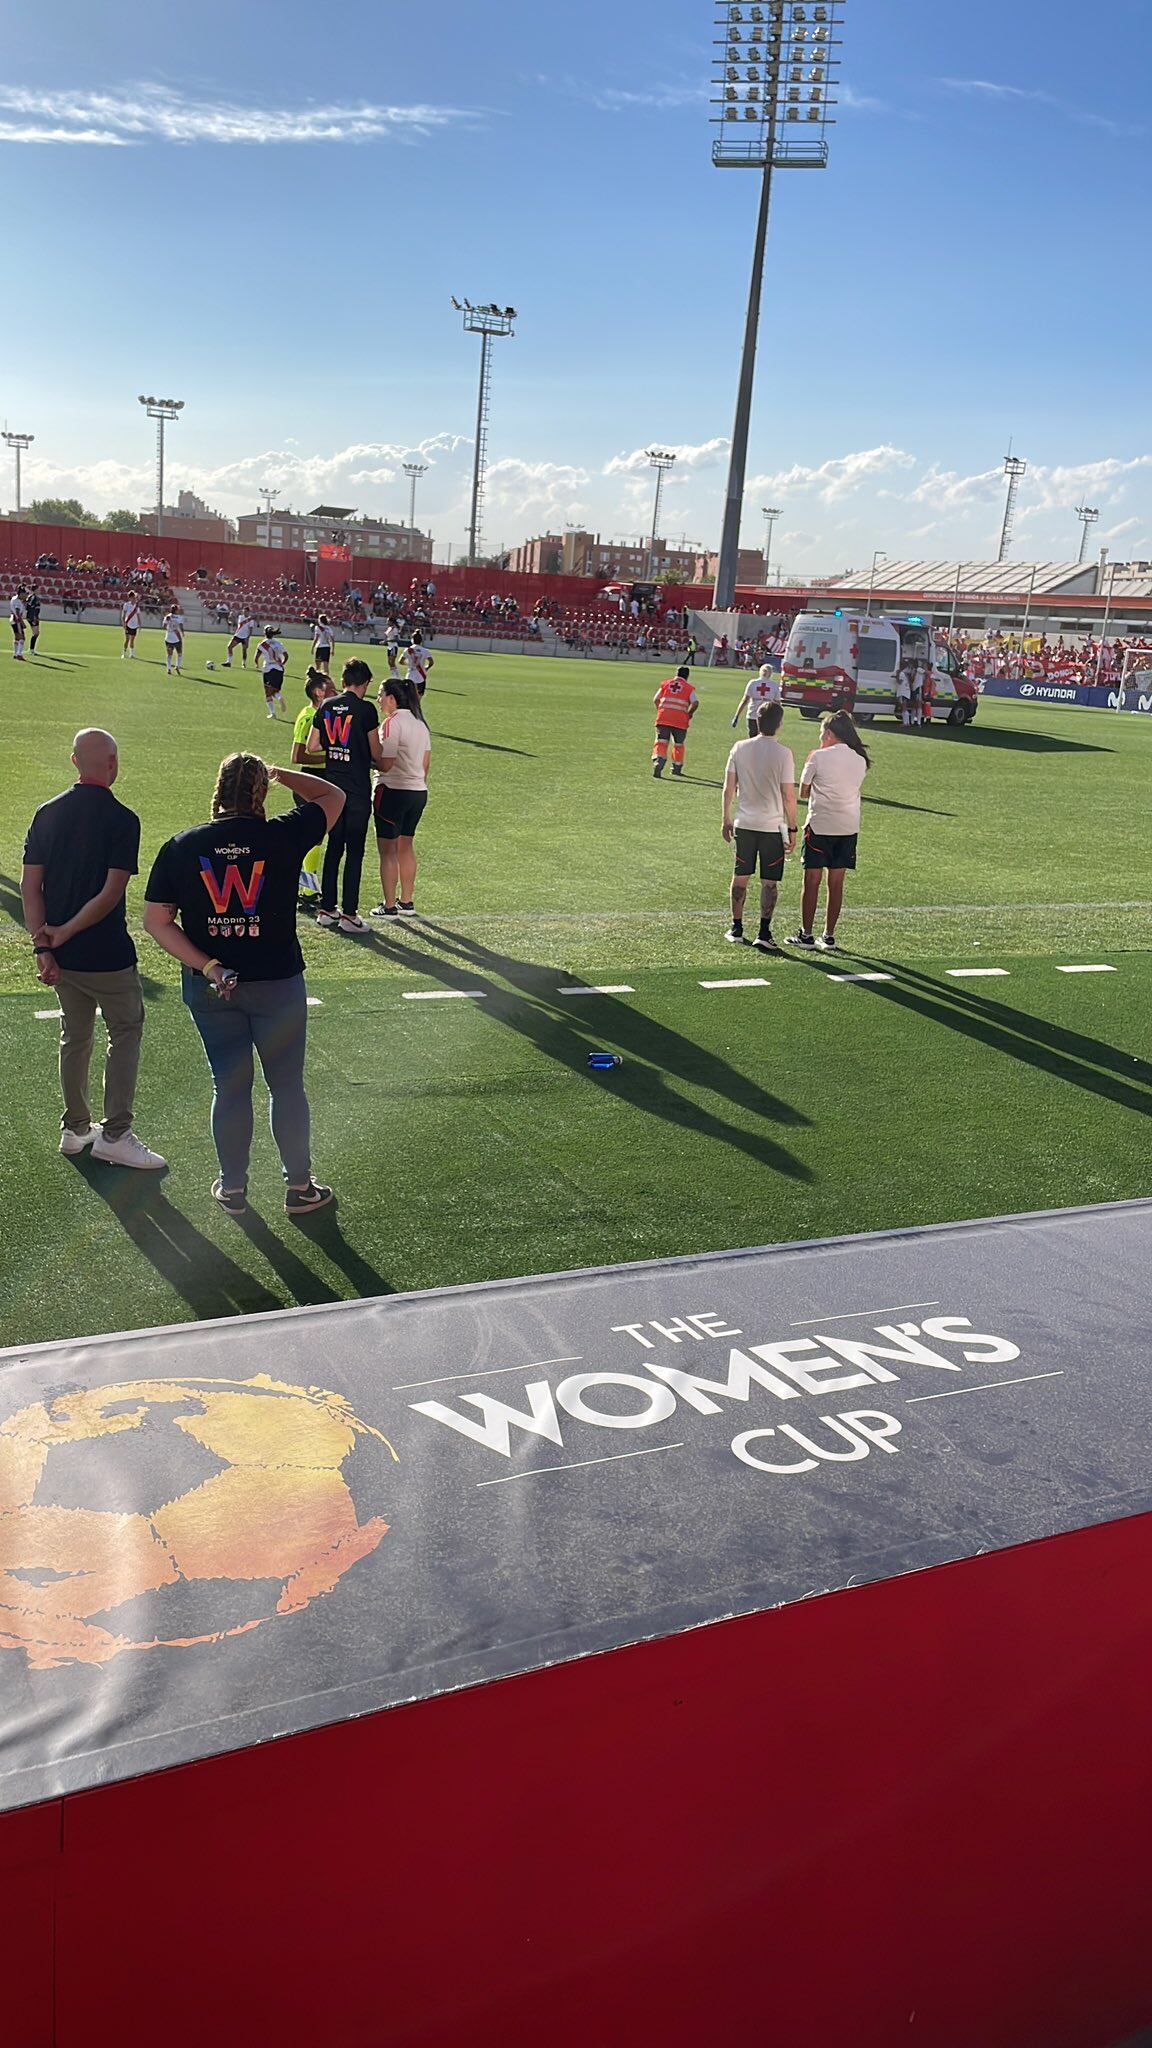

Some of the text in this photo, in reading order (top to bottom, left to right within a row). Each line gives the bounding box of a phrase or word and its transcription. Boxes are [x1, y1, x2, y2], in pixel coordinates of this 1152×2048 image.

[1036, 687, 1076, 700] HYUNDAI
[214, 847, 251, 855] WOMEN'S
[199, 856, 266, 916] W
[208, 915, 260, 925] MADRID 23
[611, 1311, 742, 1349] THE
[407, 1316, 1021, 1458] WOMEN'S
[730, 1409, 903, 1475] CUP
